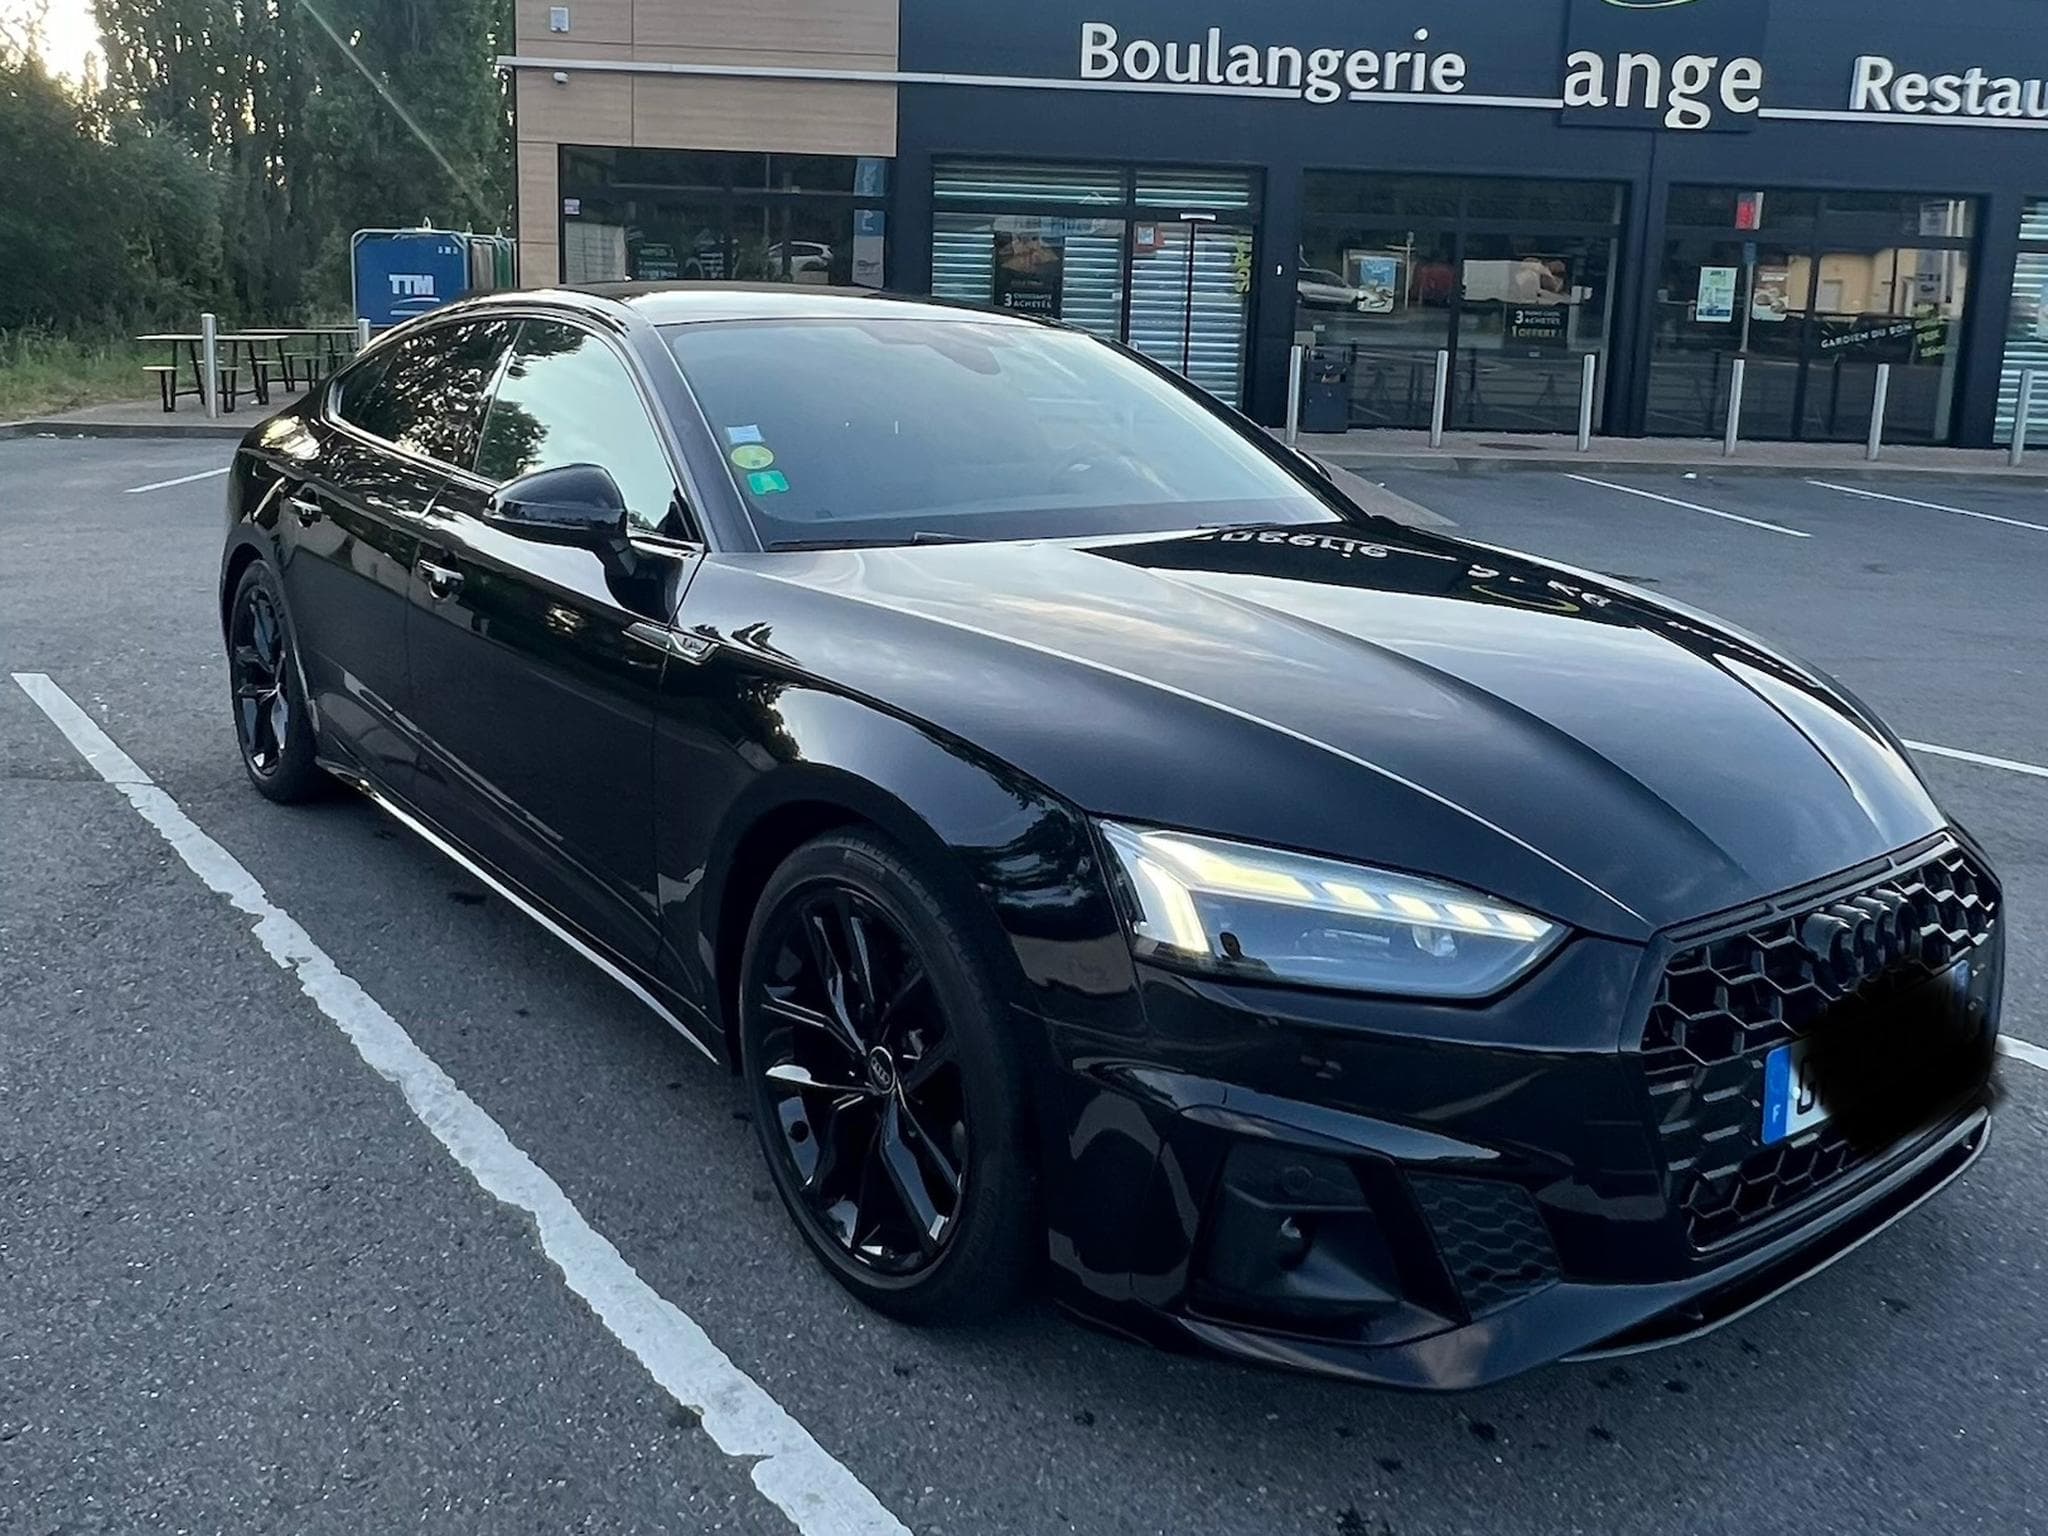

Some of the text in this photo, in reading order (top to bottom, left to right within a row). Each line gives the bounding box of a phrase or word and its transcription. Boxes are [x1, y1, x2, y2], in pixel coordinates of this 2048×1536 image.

[1080, 21, 1467, 104] Boulangerie
[1562, 49, 1764, 130] ange
[1848, 54, 2048, 118] Restau
[388, 274, 435, 295] TTM
[1004, 292, 1013, 307] 3
[1514, 310, 1524, 324] 3
[1820, 331, 1869, 348] GARDIEN
[1871, 328, 1886, 338] DU
